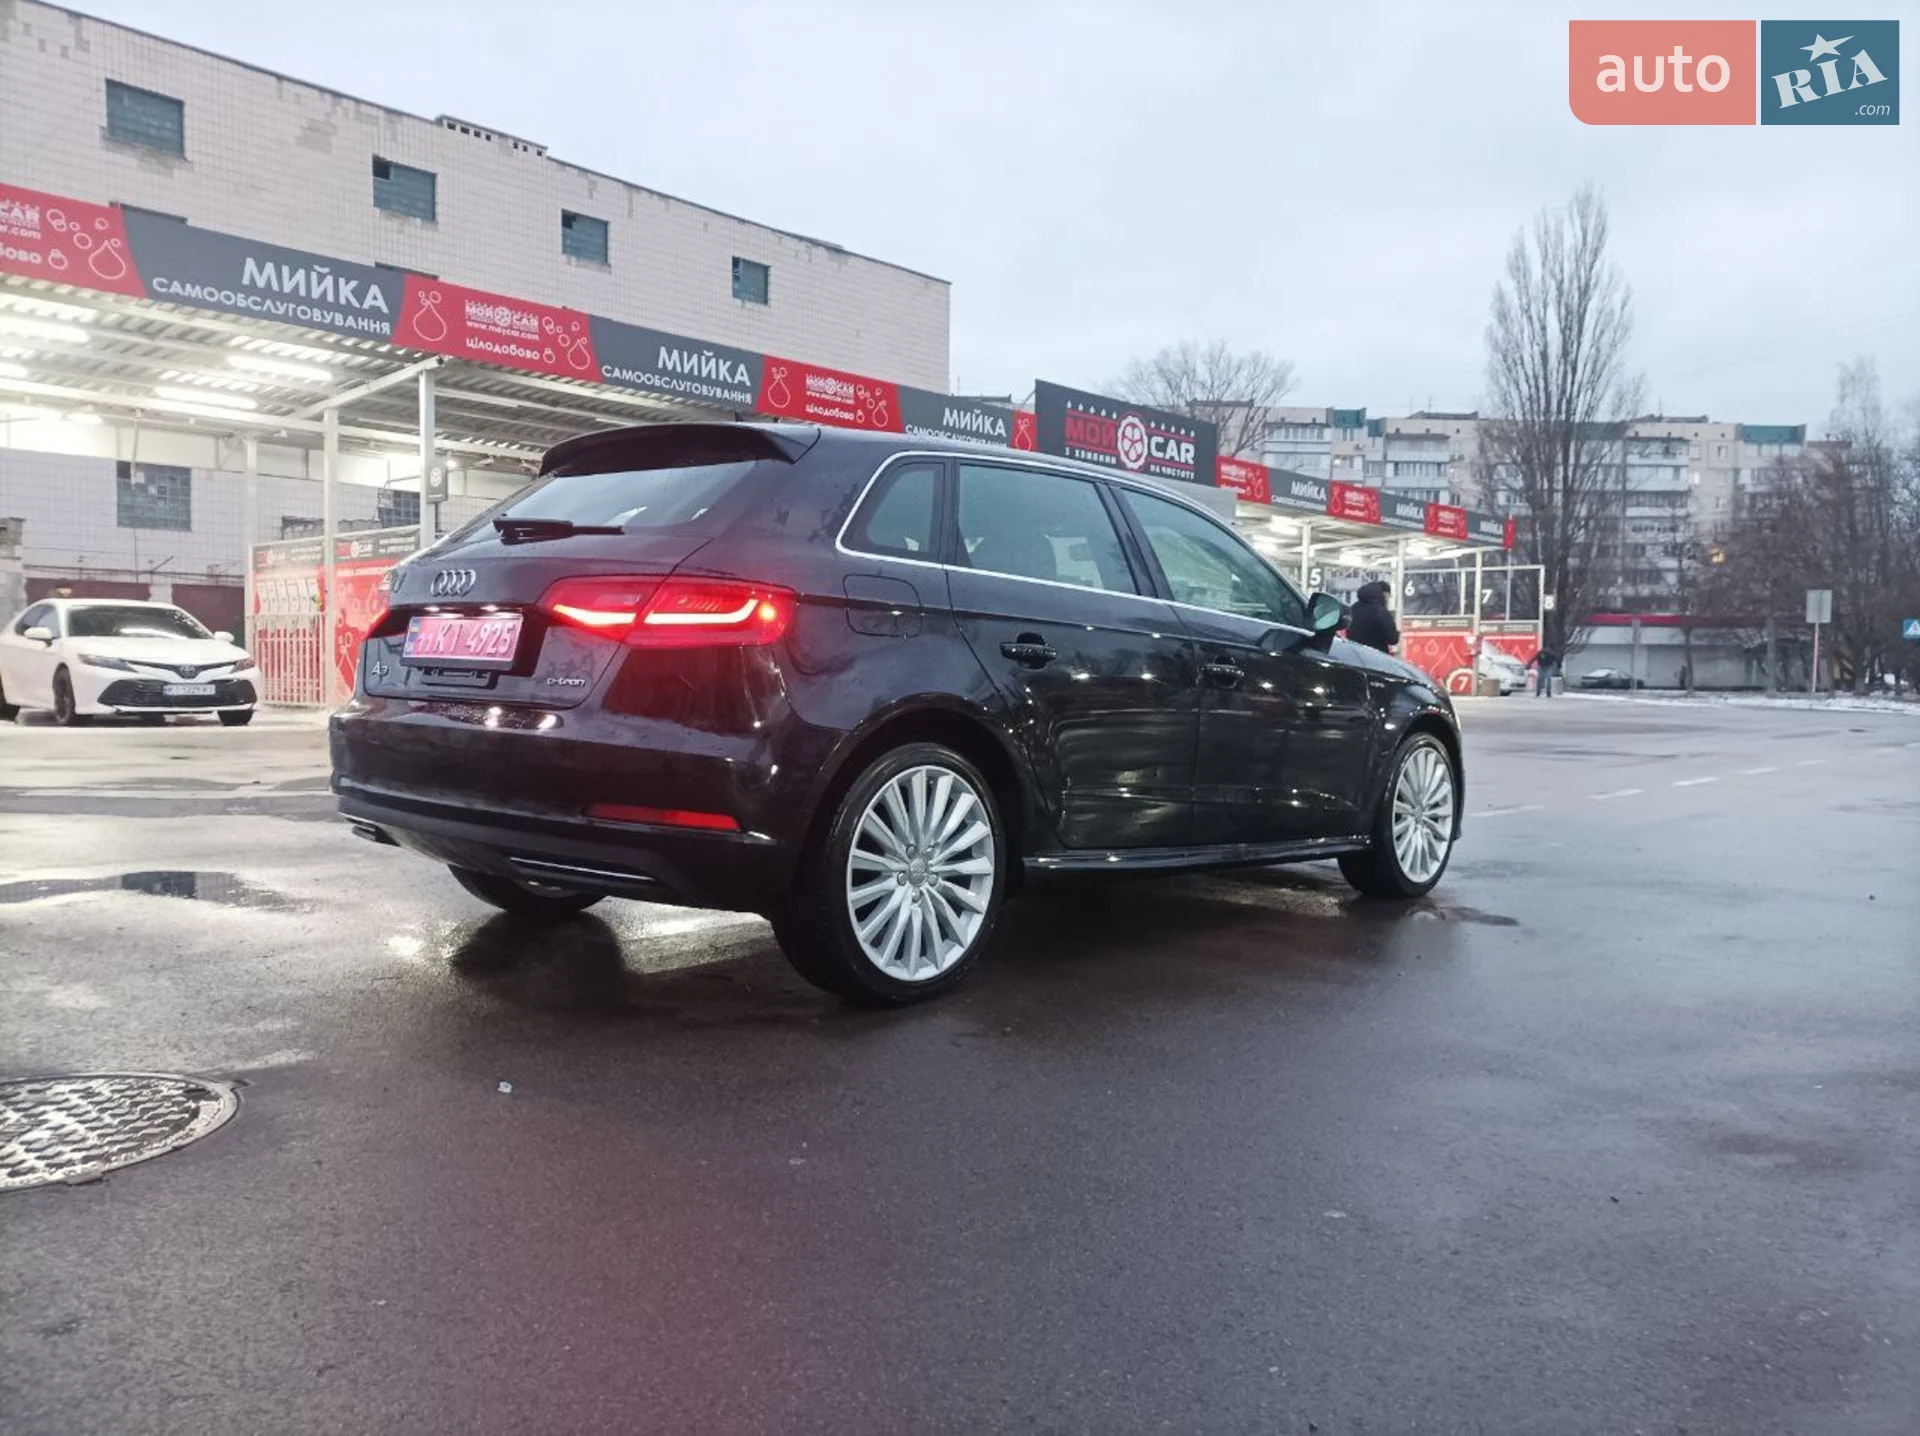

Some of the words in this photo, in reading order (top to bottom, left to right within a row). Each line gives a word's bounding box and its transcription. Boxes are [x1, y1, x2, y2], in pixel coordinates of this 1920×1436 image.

[241, 257, 390, 314] МИЙКА
[152, 276, 392, 336] САМООБСЛУГОВУВАННЯ
[657, 346, 752, 387] МИЙКА
[601, 365, 753, 405] САМООБСЛУГОВУВАННЯ
[943, 407, 1007, 438] МИЙКА
[1150, 436, 1195, 465] CAR
[1291, 480, 1327, 501] МИЙКА
[1309, 568, 1321, 586] 5
[1404, 580, 1415, 597] 6
[1481, 590, 1493, 604] 7
[465, 622, 516, 656] 4925
[1457, 676, 1468, 691] 7
